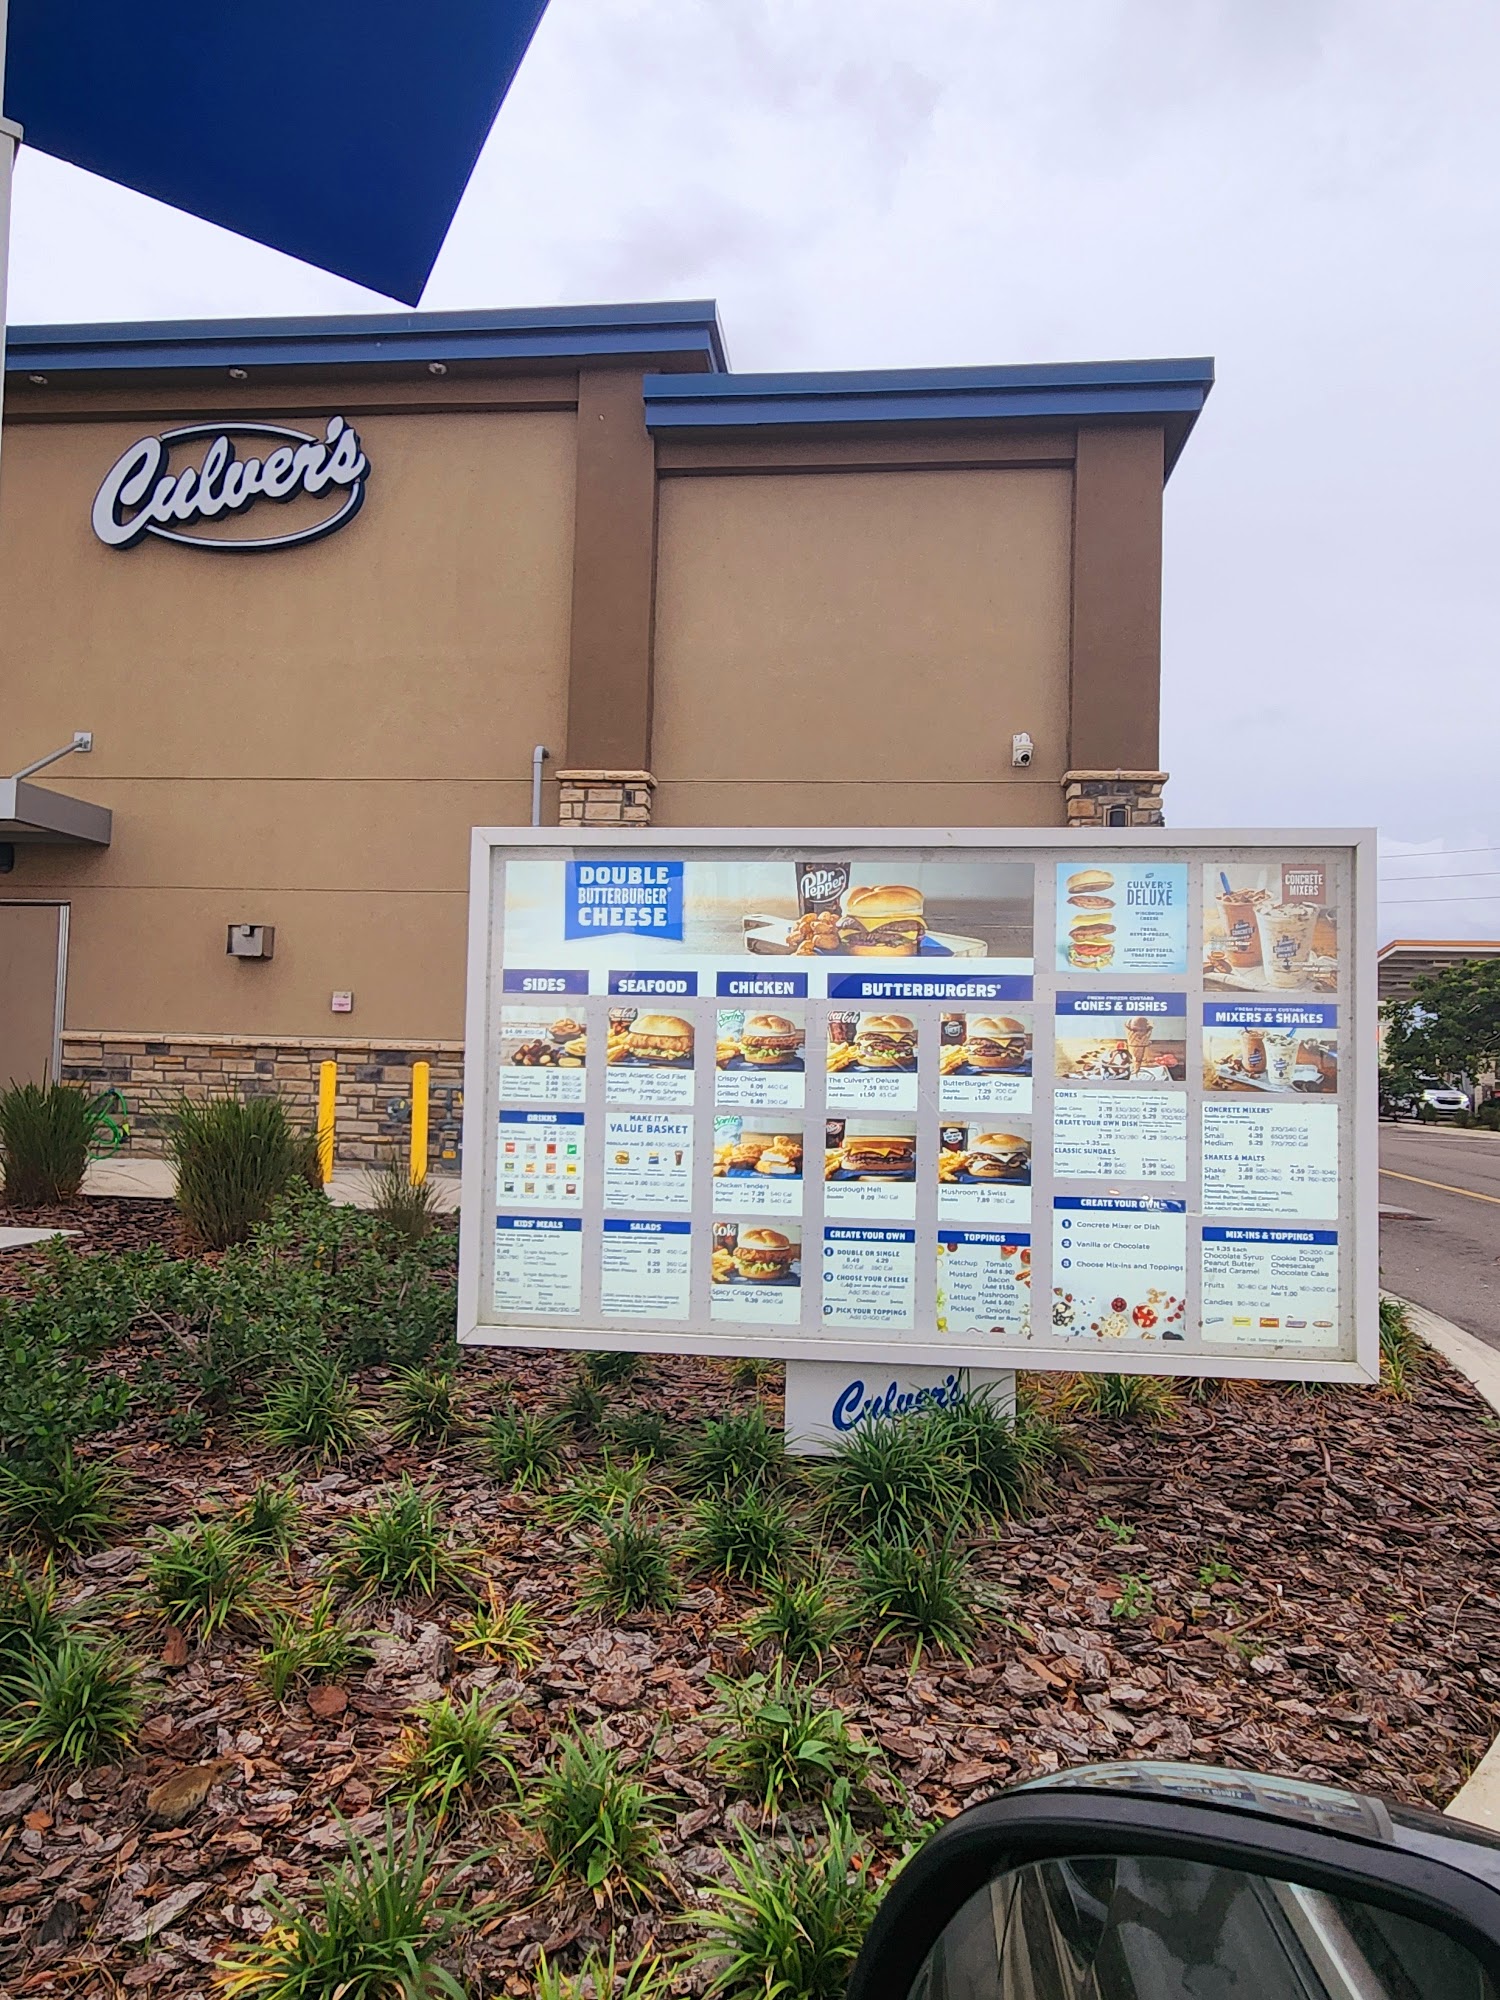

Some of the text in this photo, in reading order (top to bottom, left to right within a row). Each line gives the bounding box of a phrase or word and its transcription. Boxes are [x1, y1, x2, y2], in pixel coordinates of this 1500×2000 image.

[92, 415, 370, 548] Culver's
[579, 867, 669, 884] DOUBLE
[816, 870, 835, 885] Dr
[1285, 874, 1323, 885] CONCRETE
[801, 872, 844, 899] Pepper
[1289, 885, 1318, 896] MIXERS
[1127, 890, 1172, 906] DELUXE
[578, 907, 667, 926] CHEESE
[523, 978, 566, 992] SIDES
[618, 979, 687, 993] SEAFOOD
[730, 981, 794, 994] CHICKEN
[1074, 1001, 1167, 1011] CONES & DISHES
[1216, 1012, 1323, 1023] MIXERS & SHAKES
[610, 1124, 688, 1134] VALUE BASKET
[1081, 1199, 1159, 1209] CREATE YOUR OWN
[630, 1223, 661, 1231] SALADS
[830, 1230, 861, 1239] CREATE
[964, 1234, 1006, 1242] TOPPINGS
[1226, 1231, 1260, 1239] MIX-INS
[1270, 1232, 1314, 1241] TOPPINGS
[1150, 1264, 1183, 1272] Toppings
